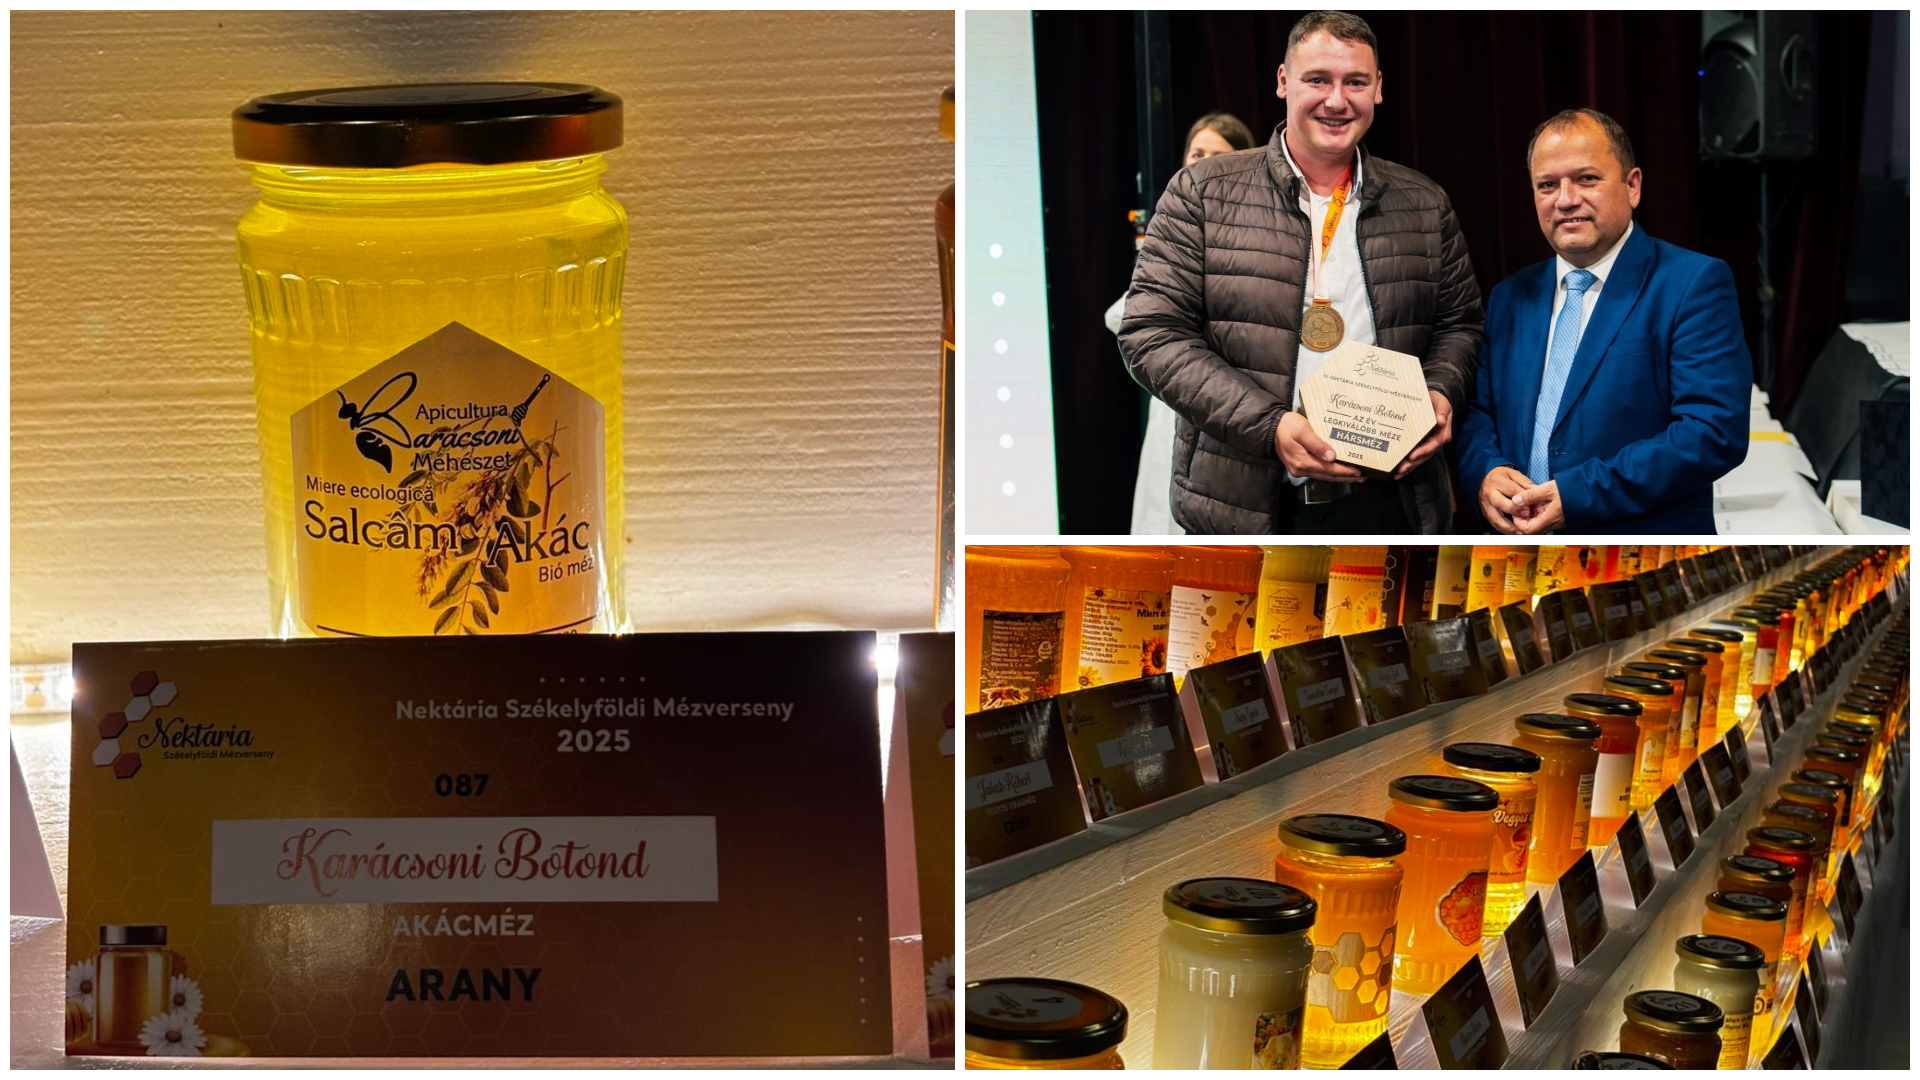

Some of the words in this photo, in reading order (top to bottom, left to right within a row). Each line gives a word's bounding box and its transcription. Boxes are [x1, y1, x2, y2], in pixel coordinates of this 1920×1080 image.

[415, 403, 508, 424] Apicultura
[1328, 393, 1373, 413] Karácsoni
[1374, 404, 1407, 422] Botond
[1366, 416, 1376, 425] ÉV
[1323, 416, 1377, 435] LEGKIVÁLÓBB
[1380, 430, 1401, 441] MÉZE
[1336, 431, 1383, 449] HÁRSMÉZ
[412, 450, 513, 472] Méhészet
[1348, 451, 1364, 460] 2025
[306, 475, 346, 496] Miere
[350, 484, 435, 502] ecologică
[304, 500, 459, 550] Salcâm
[486, 513, 590, 567] Akác
[538, 564, 563, 583] Bió
[567, 556, 594, 579] méz
[395, 699, 499, 720] Nektária
[505, 698, 646, 724] Székelyföldi
[653, 697, 794, 722] Mézverseny
[557, 729, 631, 753] 2025
[434, 774, 490, 797] 087
[1494, 811, 1528, 826] Vegyes
[277, 827, 486, 897] Karácsoni
[494, 827, 650, 881] Botond
[392, 908, 535, 936] AKÁCMÉZ
[386, 968, 542, 1002] ARANY
